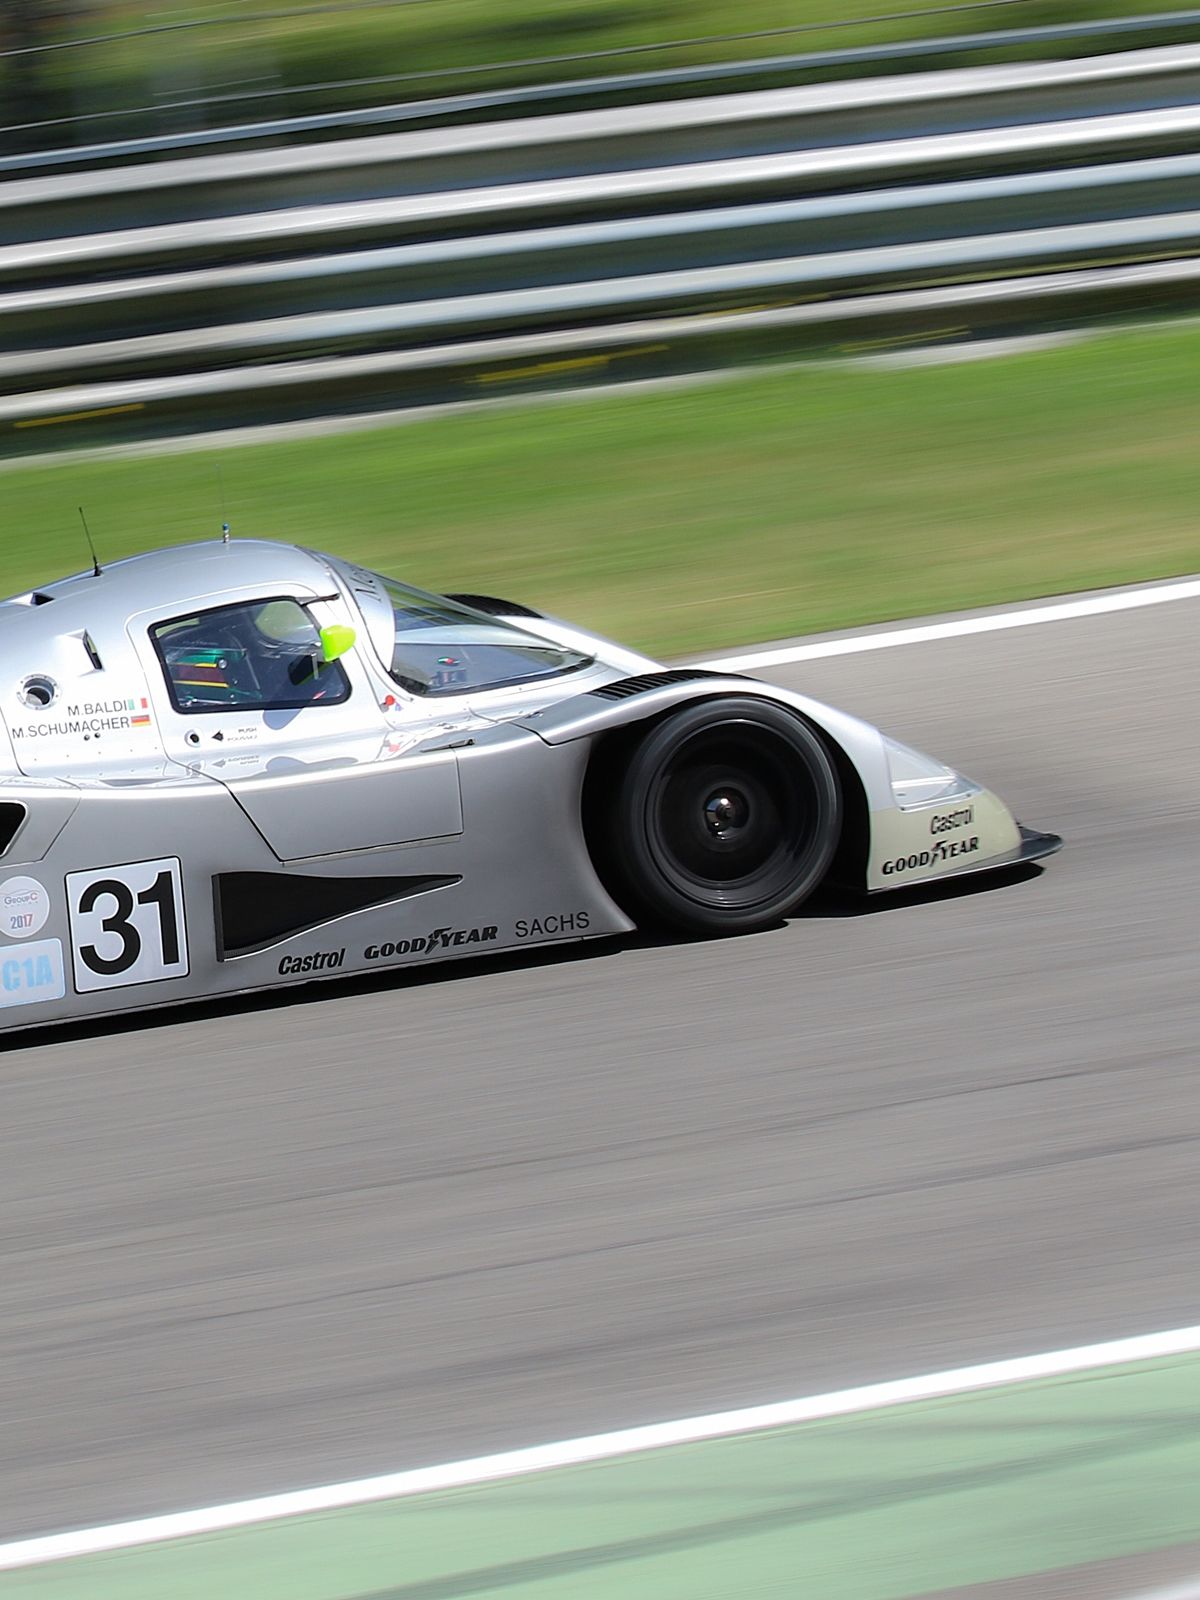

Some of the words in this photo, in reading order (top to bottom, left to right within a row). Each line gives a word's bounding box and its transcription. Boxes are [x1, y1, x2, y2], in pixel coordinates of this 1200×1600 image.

[67, 699, 128, 716] M.BALDI
[11, 716, 130, 739] M.SCHUMACHER
[930, 805, 974, 835] Castrol
[882, 836, 979, 875] GOODYEAR
[10, 914, 33, 929] 2017
[79, 871, 180, 975] 31
[278, 948, 346, 975] Castrol
[364, 926, 498, 959] GOODYEAR
[515, 911, 590, 938] SACHS
[2, 954, 54, 991] C1A
